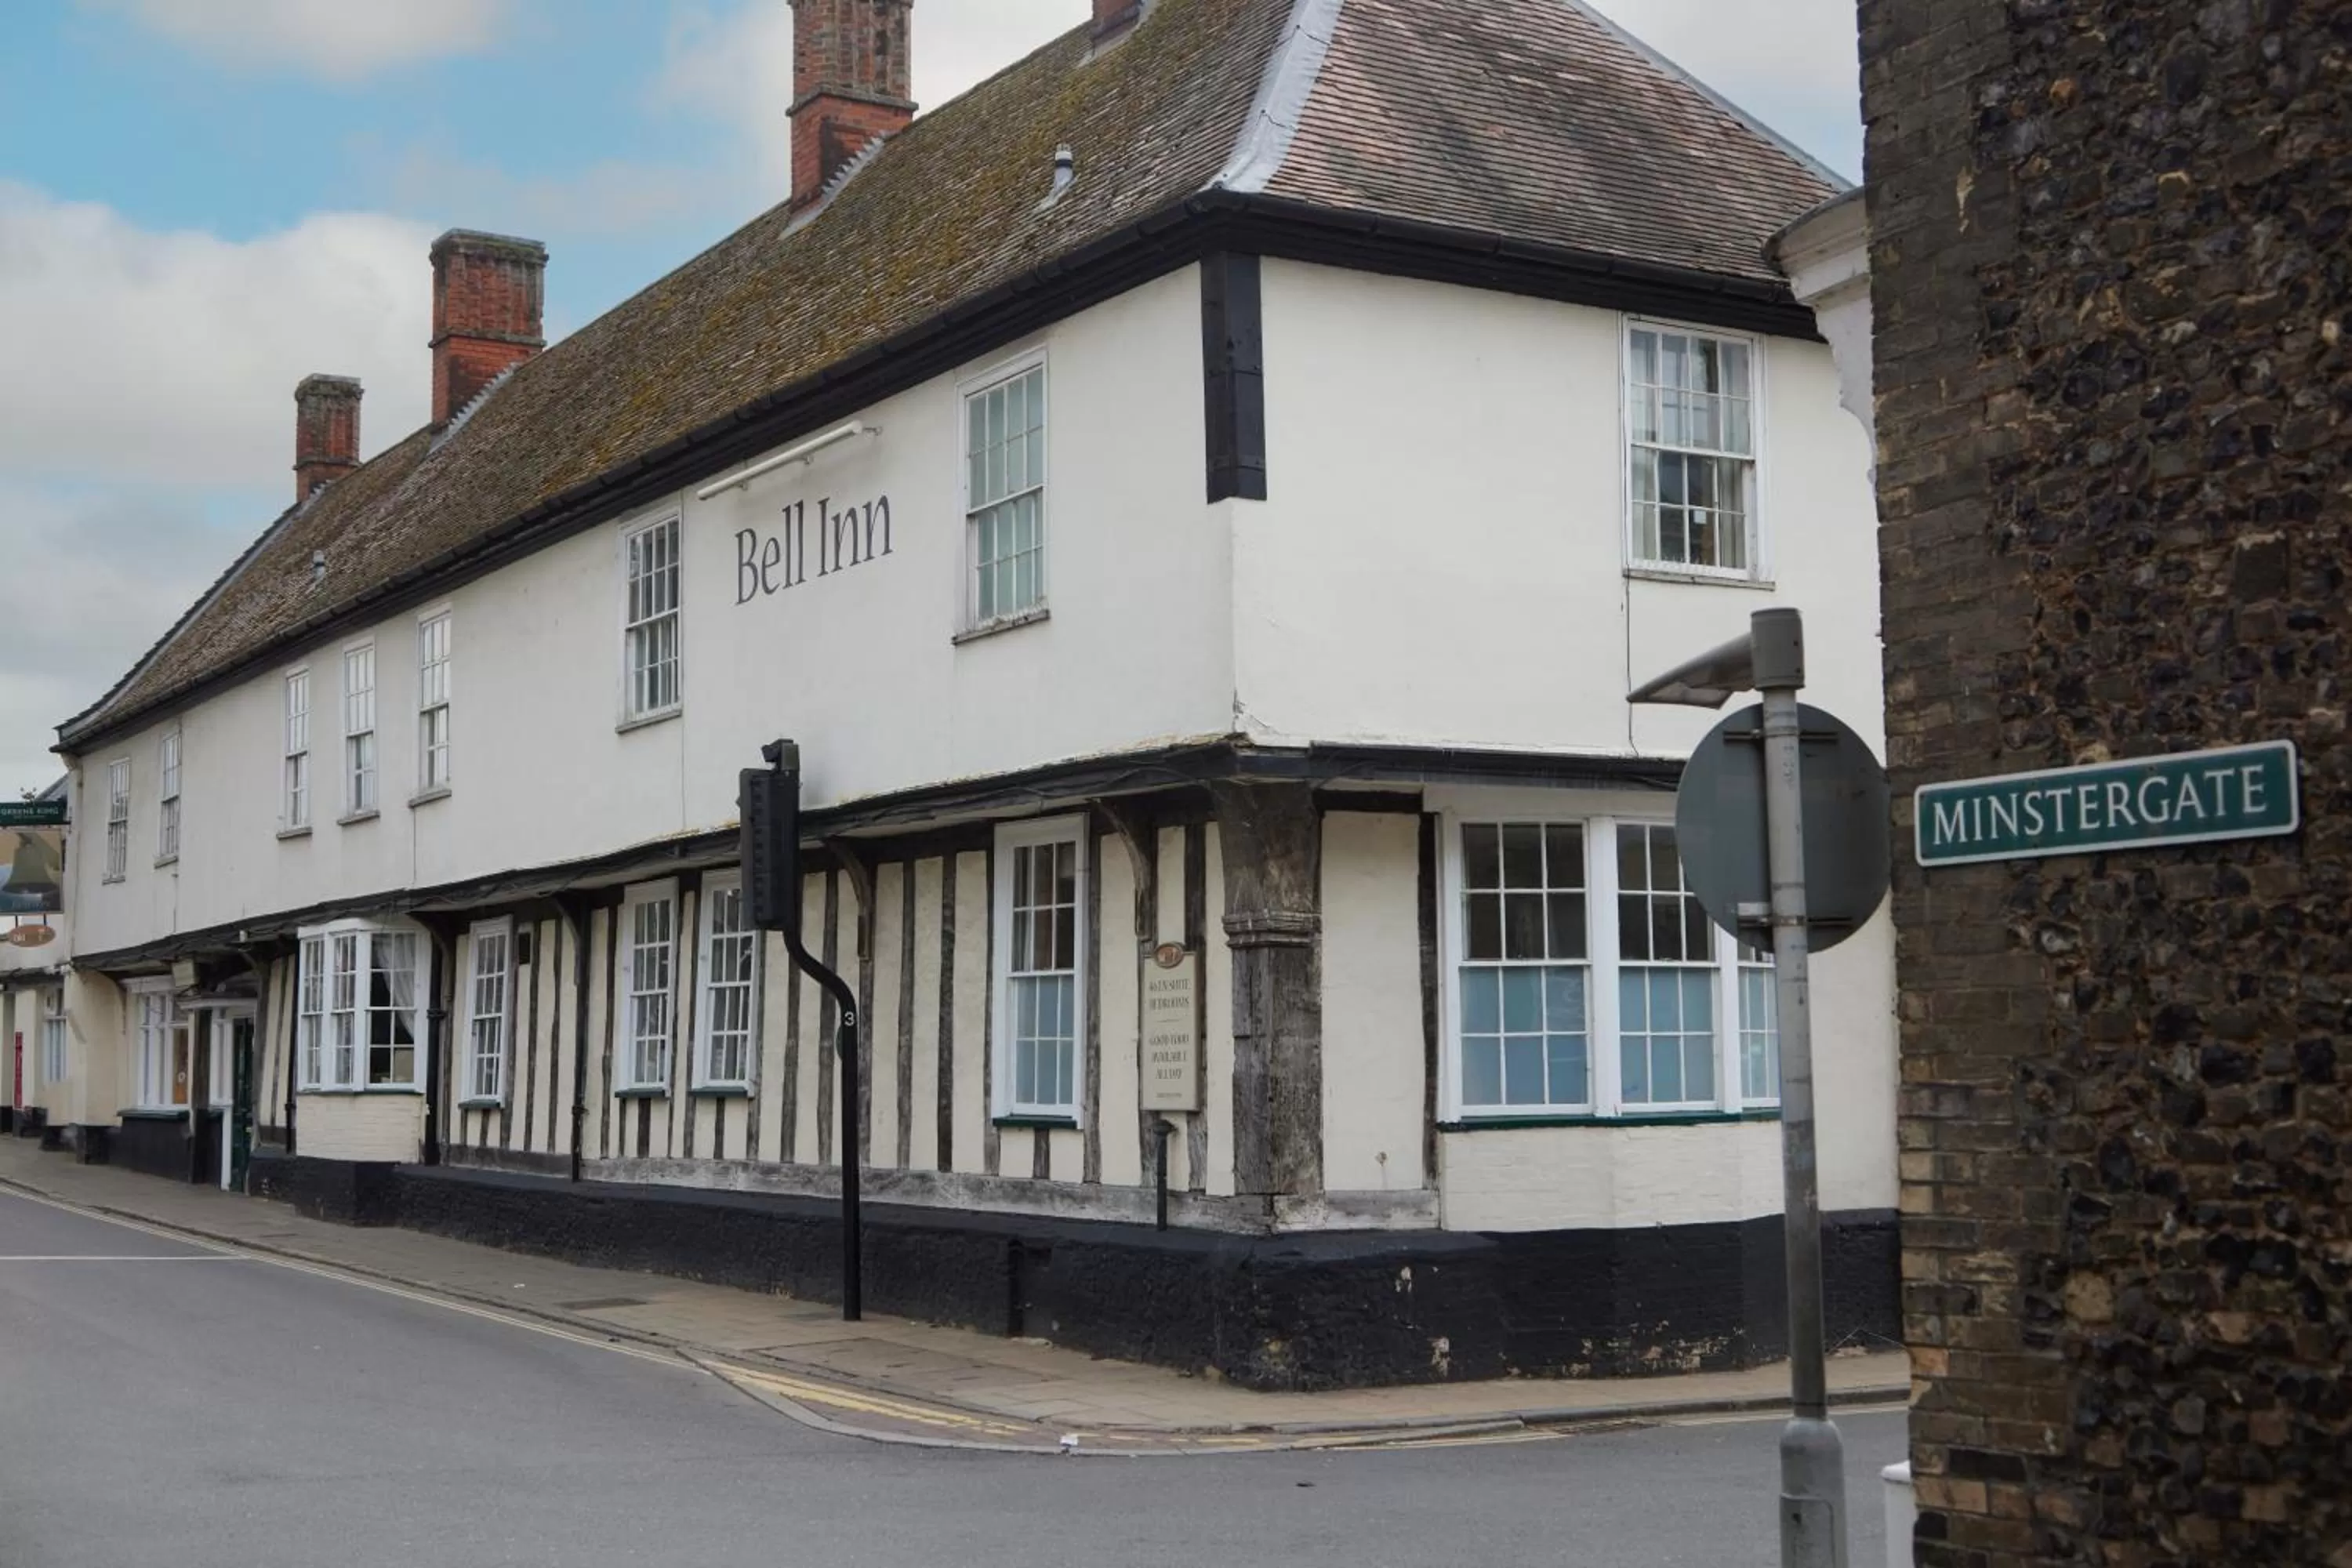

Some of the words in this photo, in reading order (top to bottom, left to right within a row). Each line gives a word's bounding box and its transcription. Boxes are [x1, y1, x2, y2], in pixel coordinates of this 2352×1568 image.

[735, 499, 806, 605] Bell
[817, 495, 893, 577] Inn
[1932, 764, 2267, 846] MINSTERGATE
[844, 1011, 855, 1026] 3
